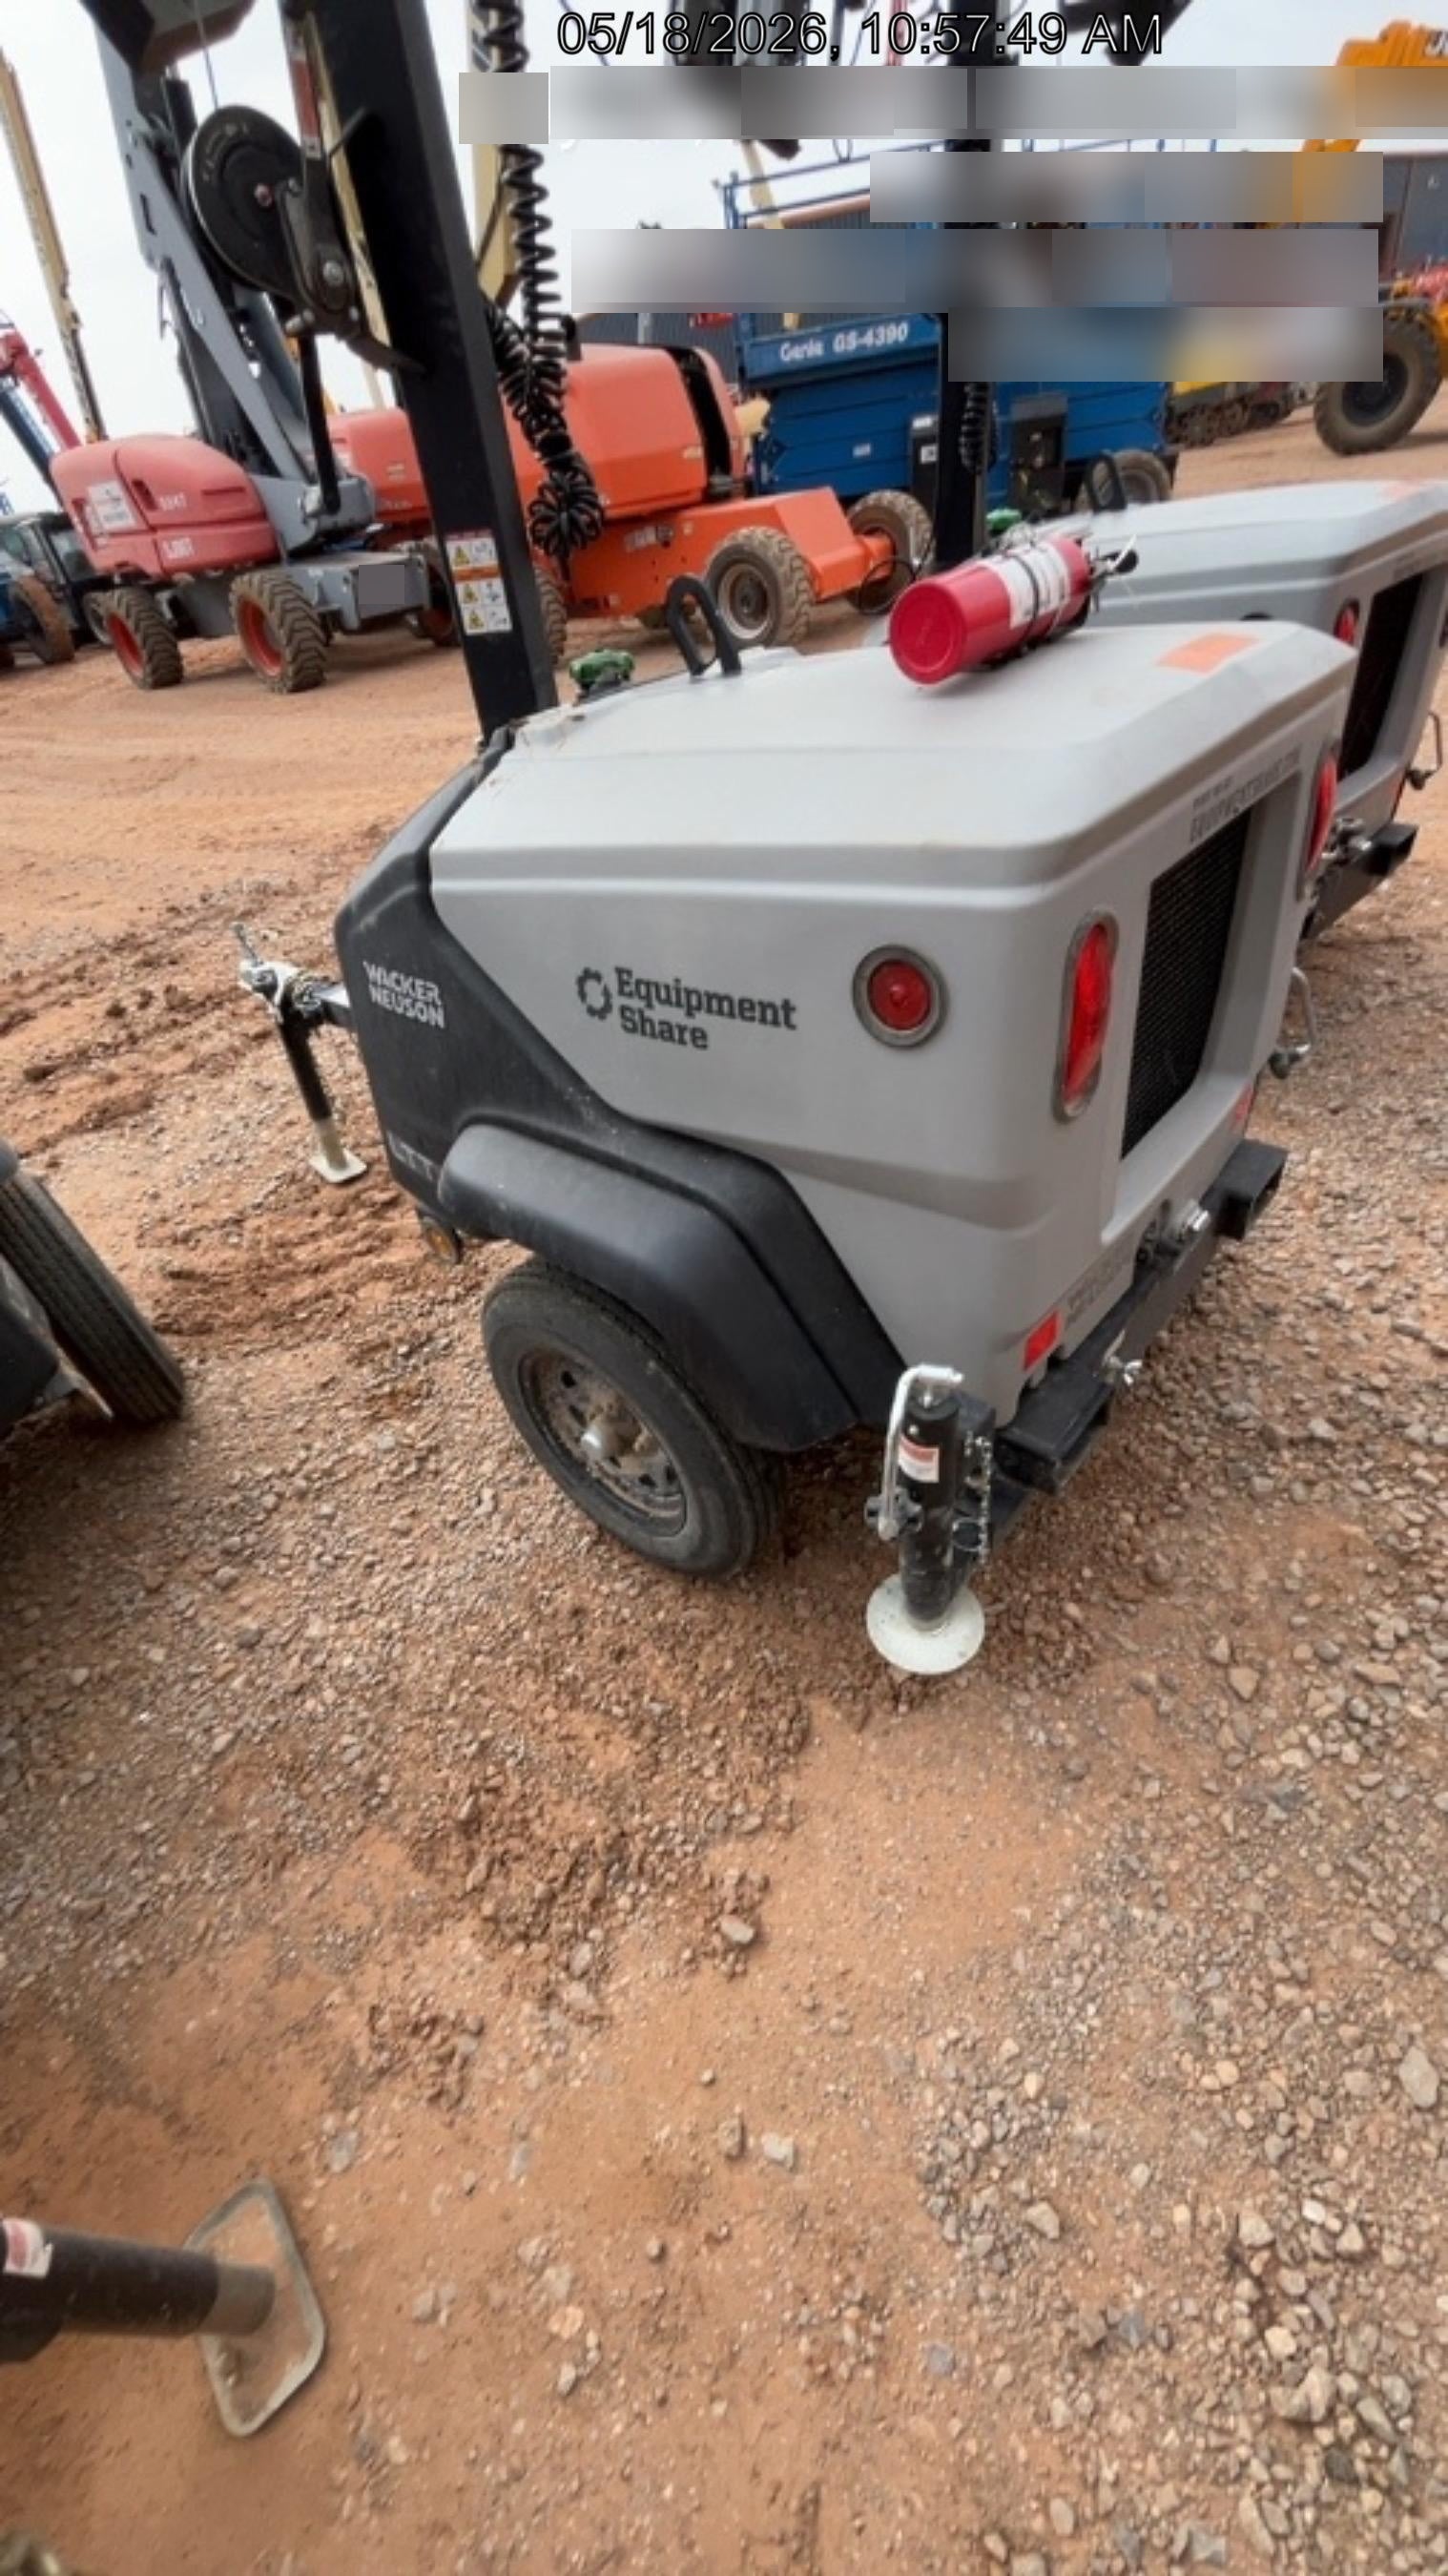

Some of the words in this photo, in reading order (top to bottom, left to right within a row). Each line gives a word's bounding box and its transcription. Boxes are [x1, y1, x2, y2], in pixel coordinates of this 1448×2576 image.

[779, 339, 824, 363] Genie
[832, 322, 909, 353] GS-4390
[363, 961, 442, 1006] WACKER
[368, 984, 445, 1028] NEUSON
[615, 966, 796, 1031] Equipment
[619, 1004, 709, 1050] Share
